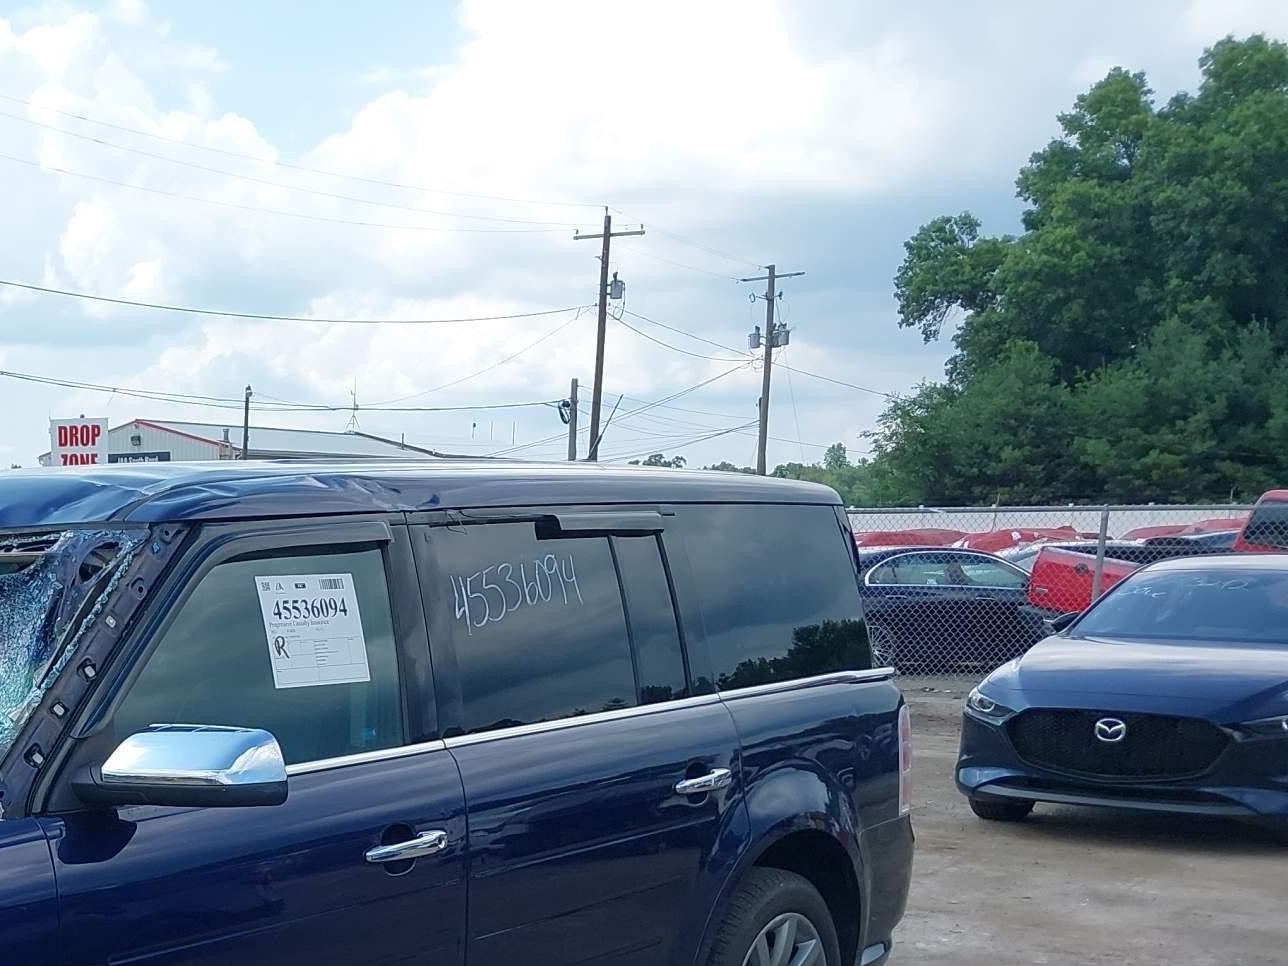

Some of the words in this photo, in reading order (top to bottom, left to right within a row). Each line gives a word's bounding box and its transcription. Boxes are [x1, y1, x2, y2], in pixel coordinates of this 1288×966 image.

[58, 425, 100, 447] DROP
[450, 554, 583, 636] 45536094
[272, 597, 348, 620] 45536094
[274, 635, 290, 659] R
